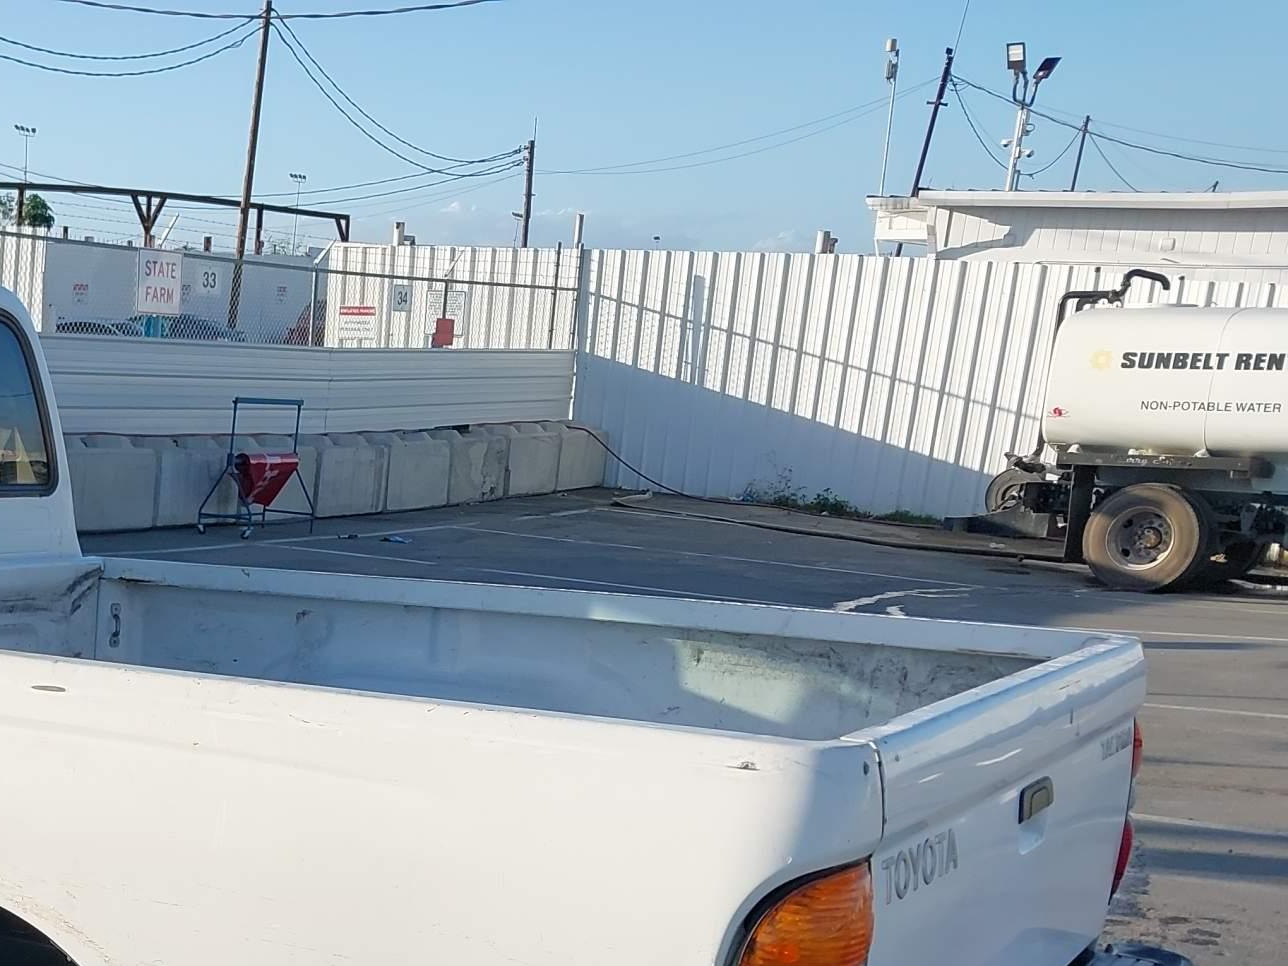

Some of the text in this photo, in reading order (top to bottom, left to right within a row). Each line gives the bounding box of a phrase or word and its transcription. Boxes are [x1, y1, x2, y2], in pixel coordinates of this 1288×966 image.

[144, 259, 177, 279] STATE
[202, 271, 217, 289] 33
[145, 286, 174, 303] FARM
[397, 291, 408, 306] 34
[1120, 351, 1286, 371] SUNBELT REN
[1140, 400, 1282, 413] NON-POTABLE WATER
[881, 828, 959, 905] TOYOTA
